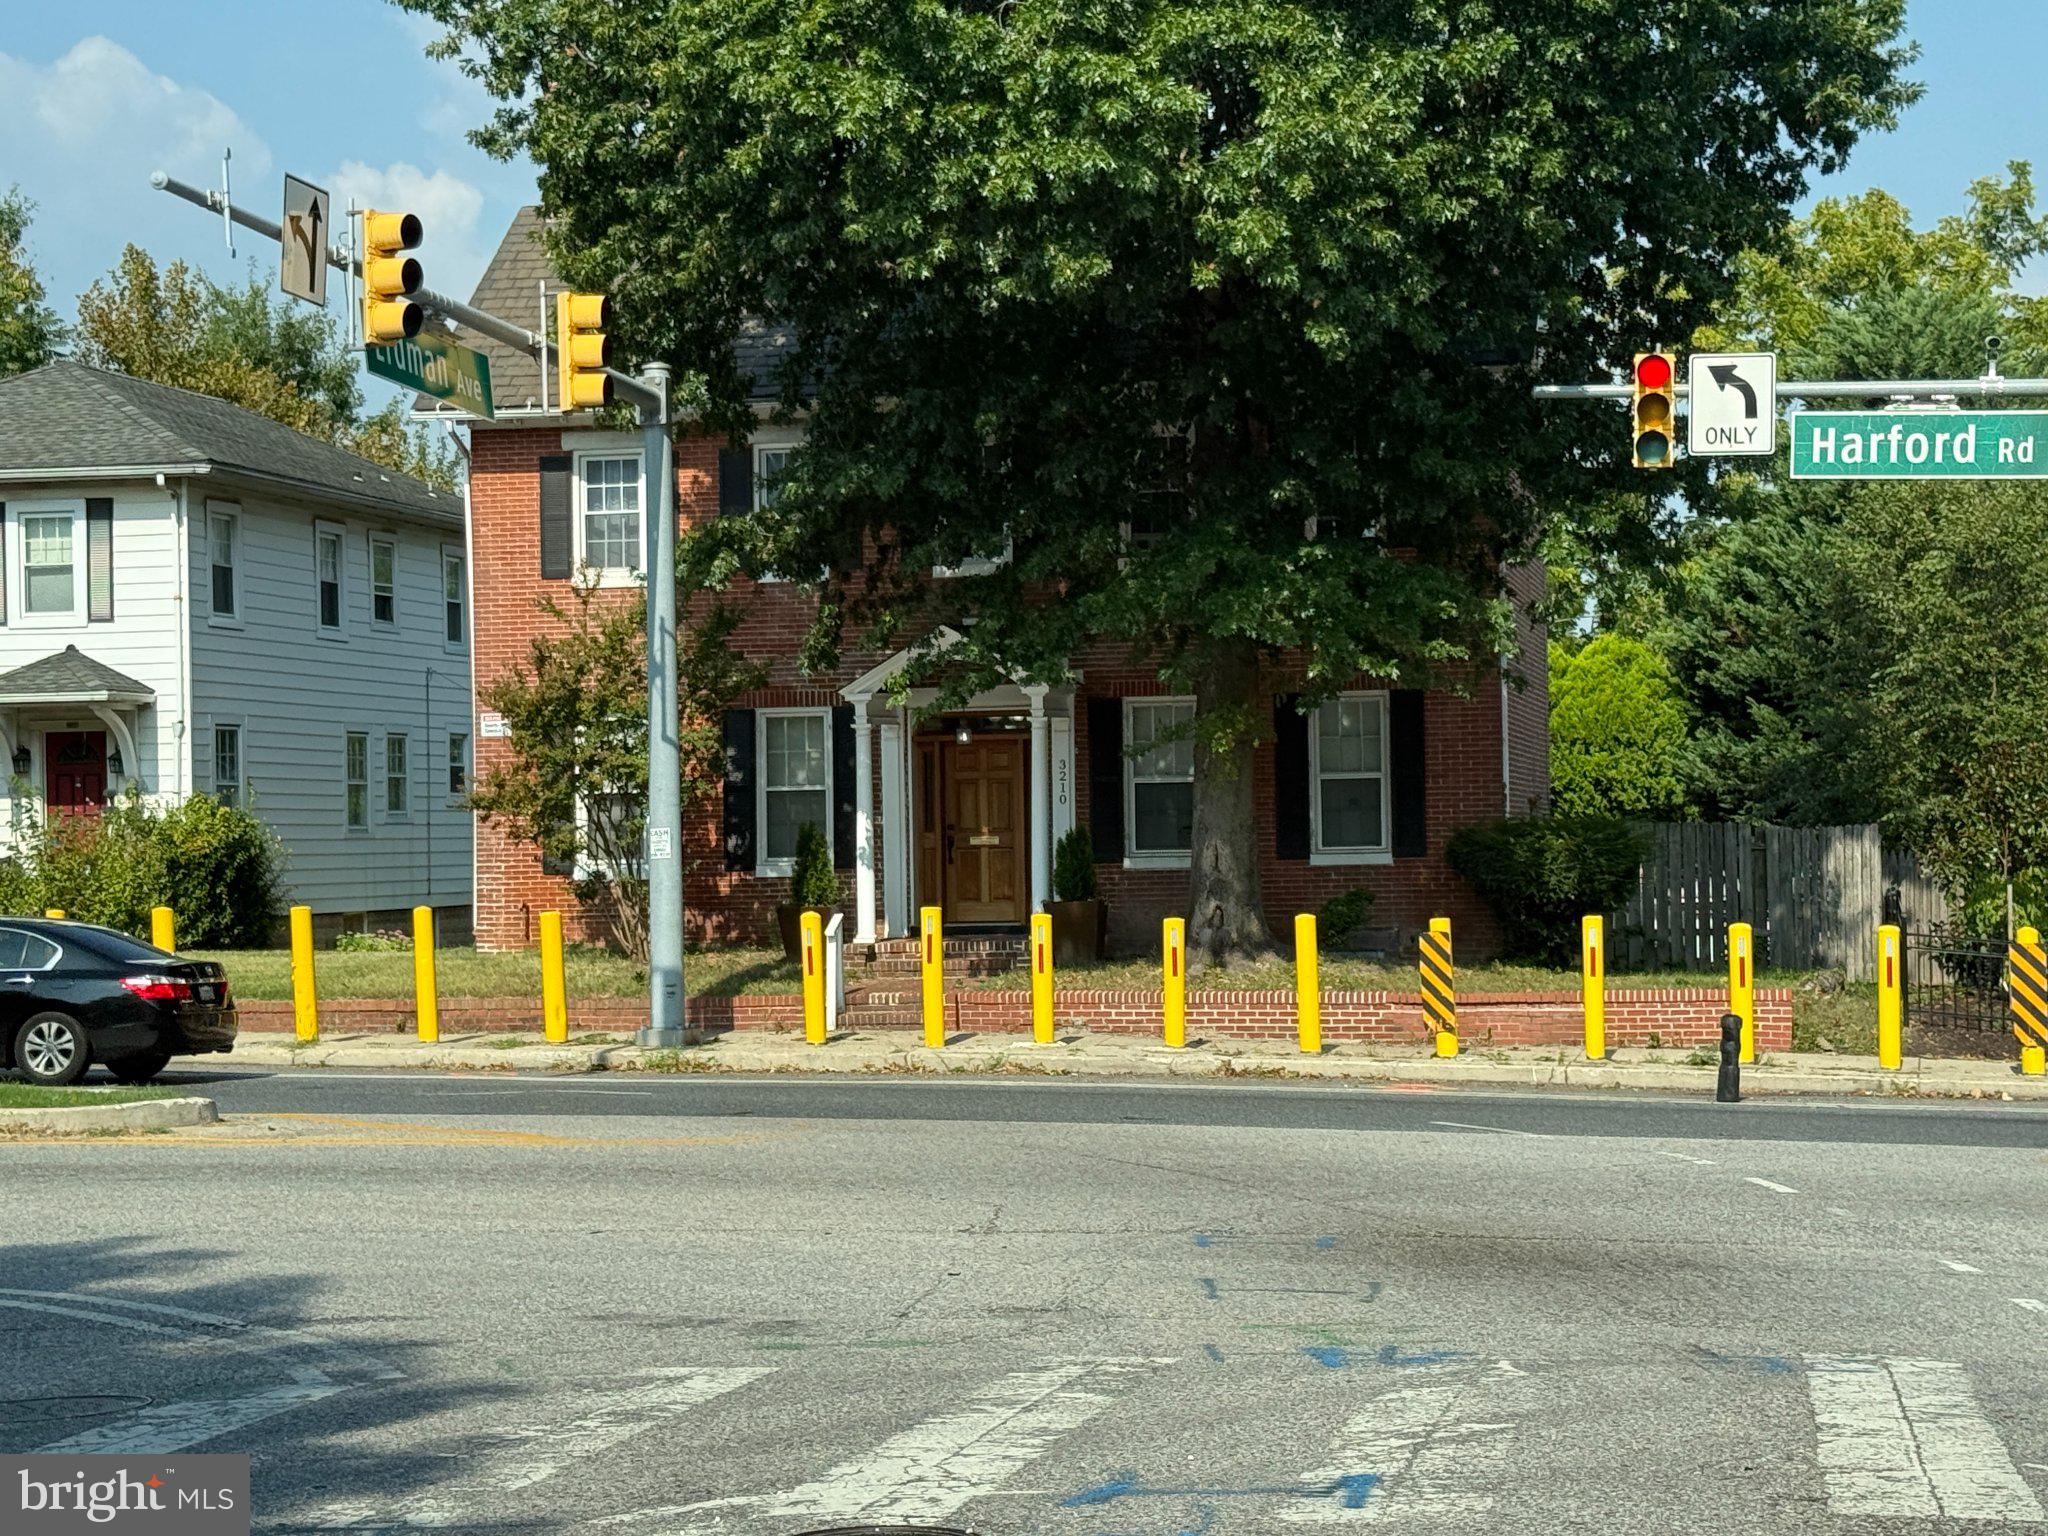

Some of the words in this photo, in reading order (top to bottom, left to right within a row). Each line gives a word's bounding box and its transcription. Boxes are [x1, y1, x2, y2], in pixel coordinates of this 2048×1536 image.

[457, 369, 482, 402] Ave
[1705, 427, 1758, 445] ONLY
[1812, 424, 1976, 464] Harford
[1998, 435, 2034, 464] Rd
[1058, 759, 1067, 805] 3210
